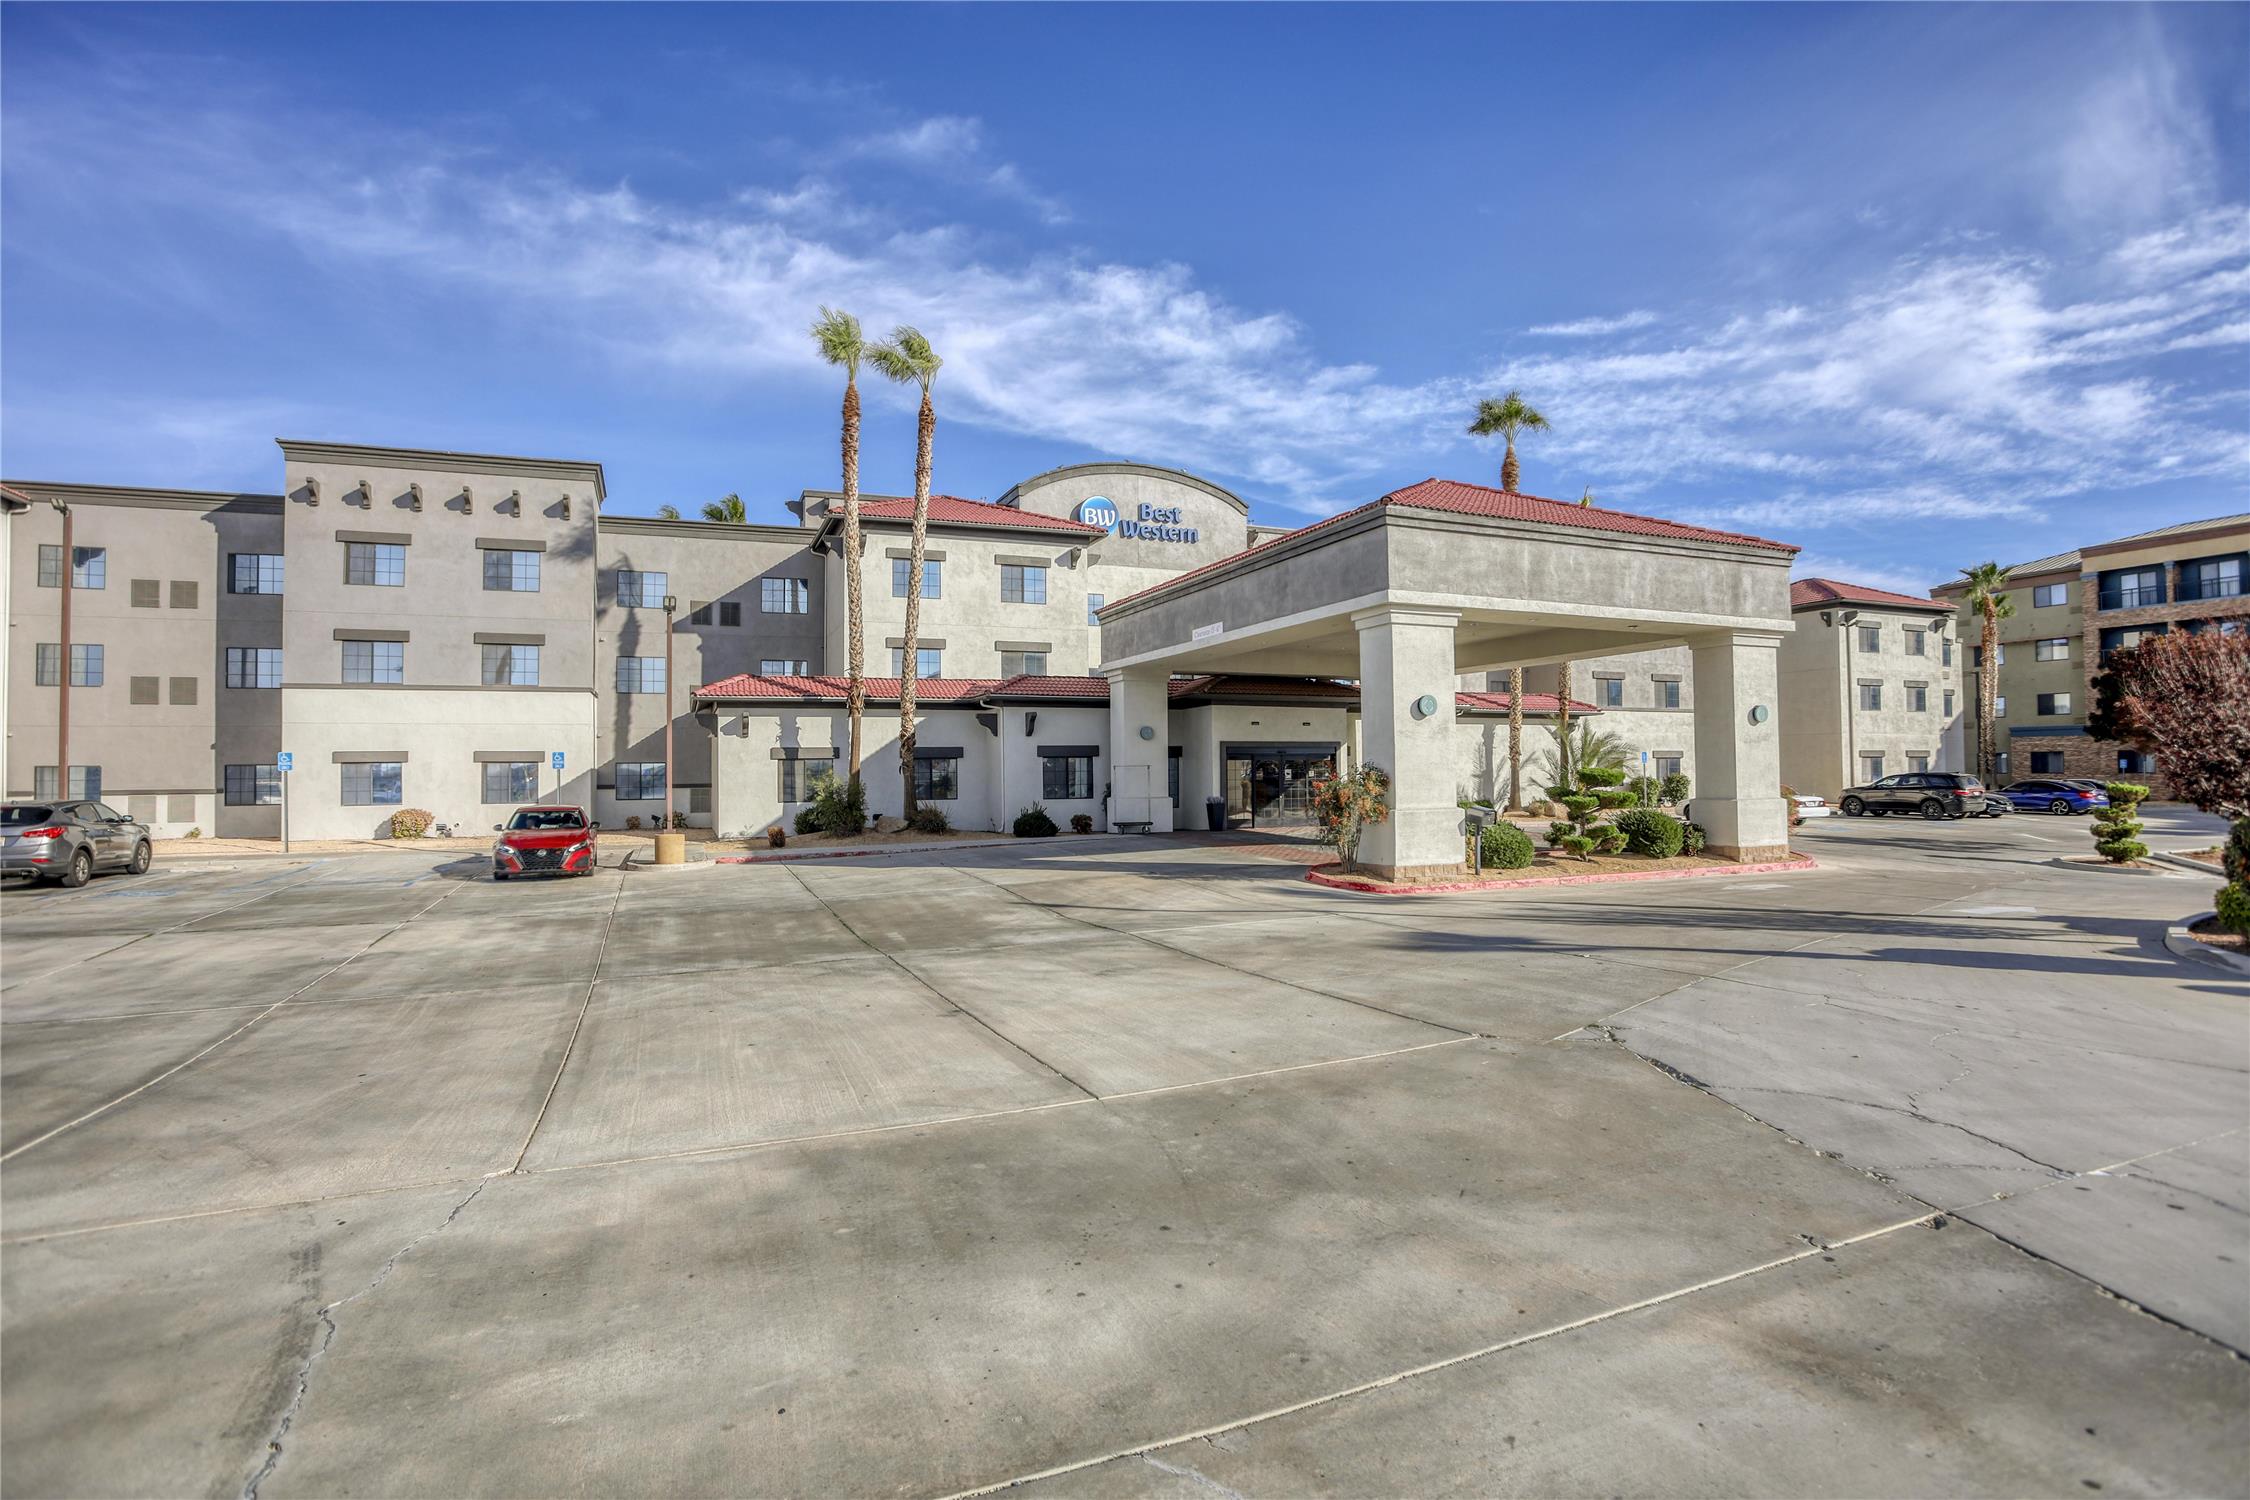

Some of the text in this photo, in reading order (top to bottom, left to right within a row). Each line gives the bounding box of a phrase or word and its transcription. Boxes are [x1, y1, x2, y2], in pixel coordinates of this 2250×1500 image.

[1084, 508, 1116, 527] BW
[1139, 502, 1182, 524] Best
[1119, 520, 1199, 544] Western
